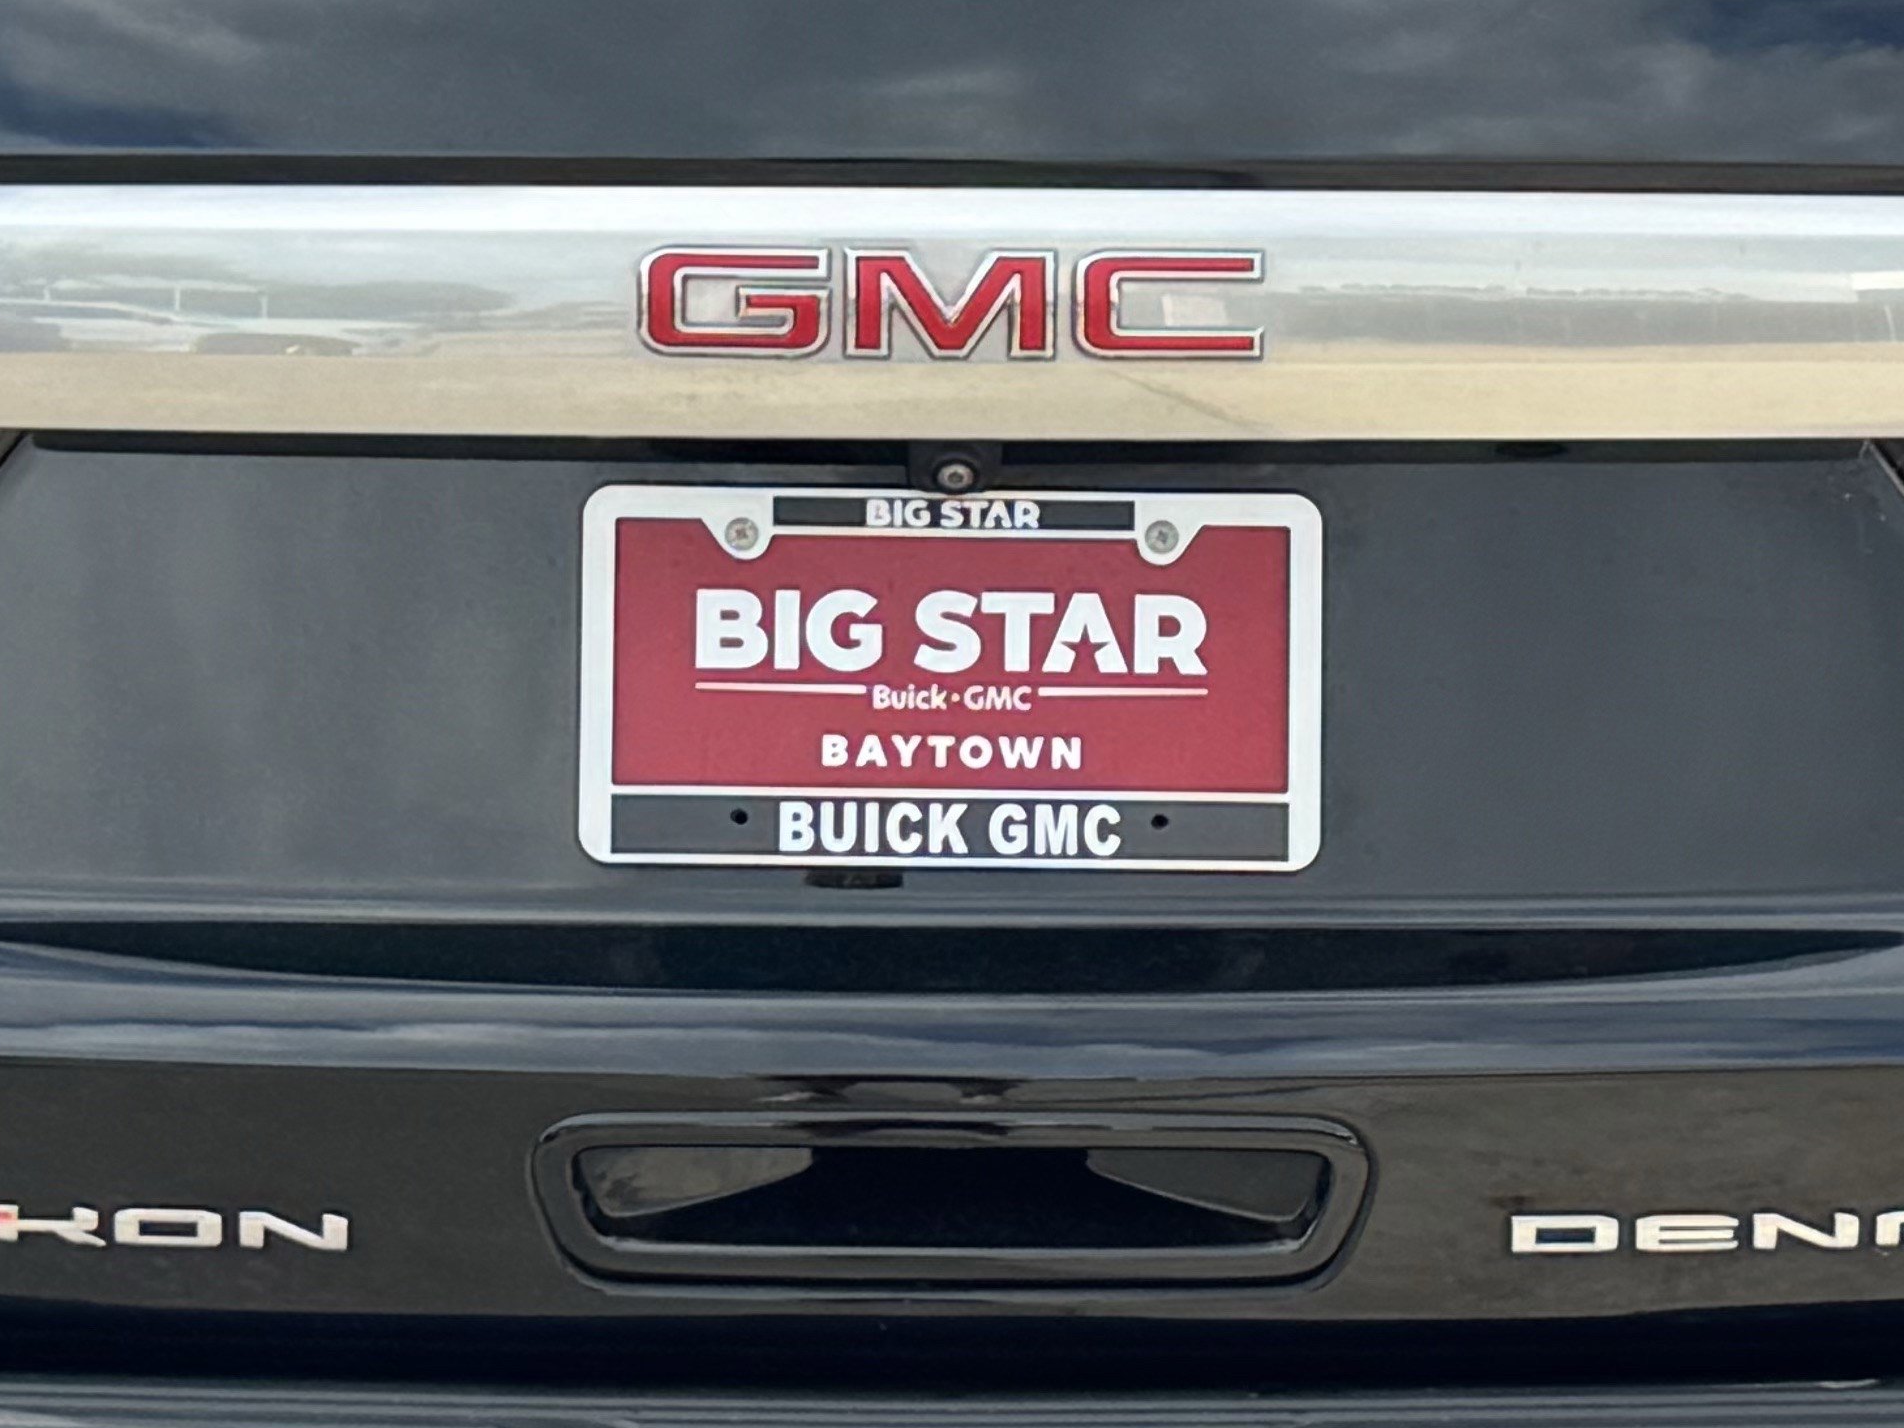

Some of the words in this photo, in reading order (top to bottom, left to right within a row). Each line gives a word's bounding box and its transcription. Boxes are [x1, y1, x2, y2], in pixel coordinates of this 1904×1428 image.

[639, 246, 1264, 359] GMC
[865, 499, 931, 528] BIG
[940, 500, 1041, 530] STAR
[694, 588, 884, 673] BIG
[913, 590, 1209, 677] STAR
[820, 734, 1083, 771] BAYTOWN
[778, 801, 969, 855] BUICK
[988, 803, 1123, 858] GMC
